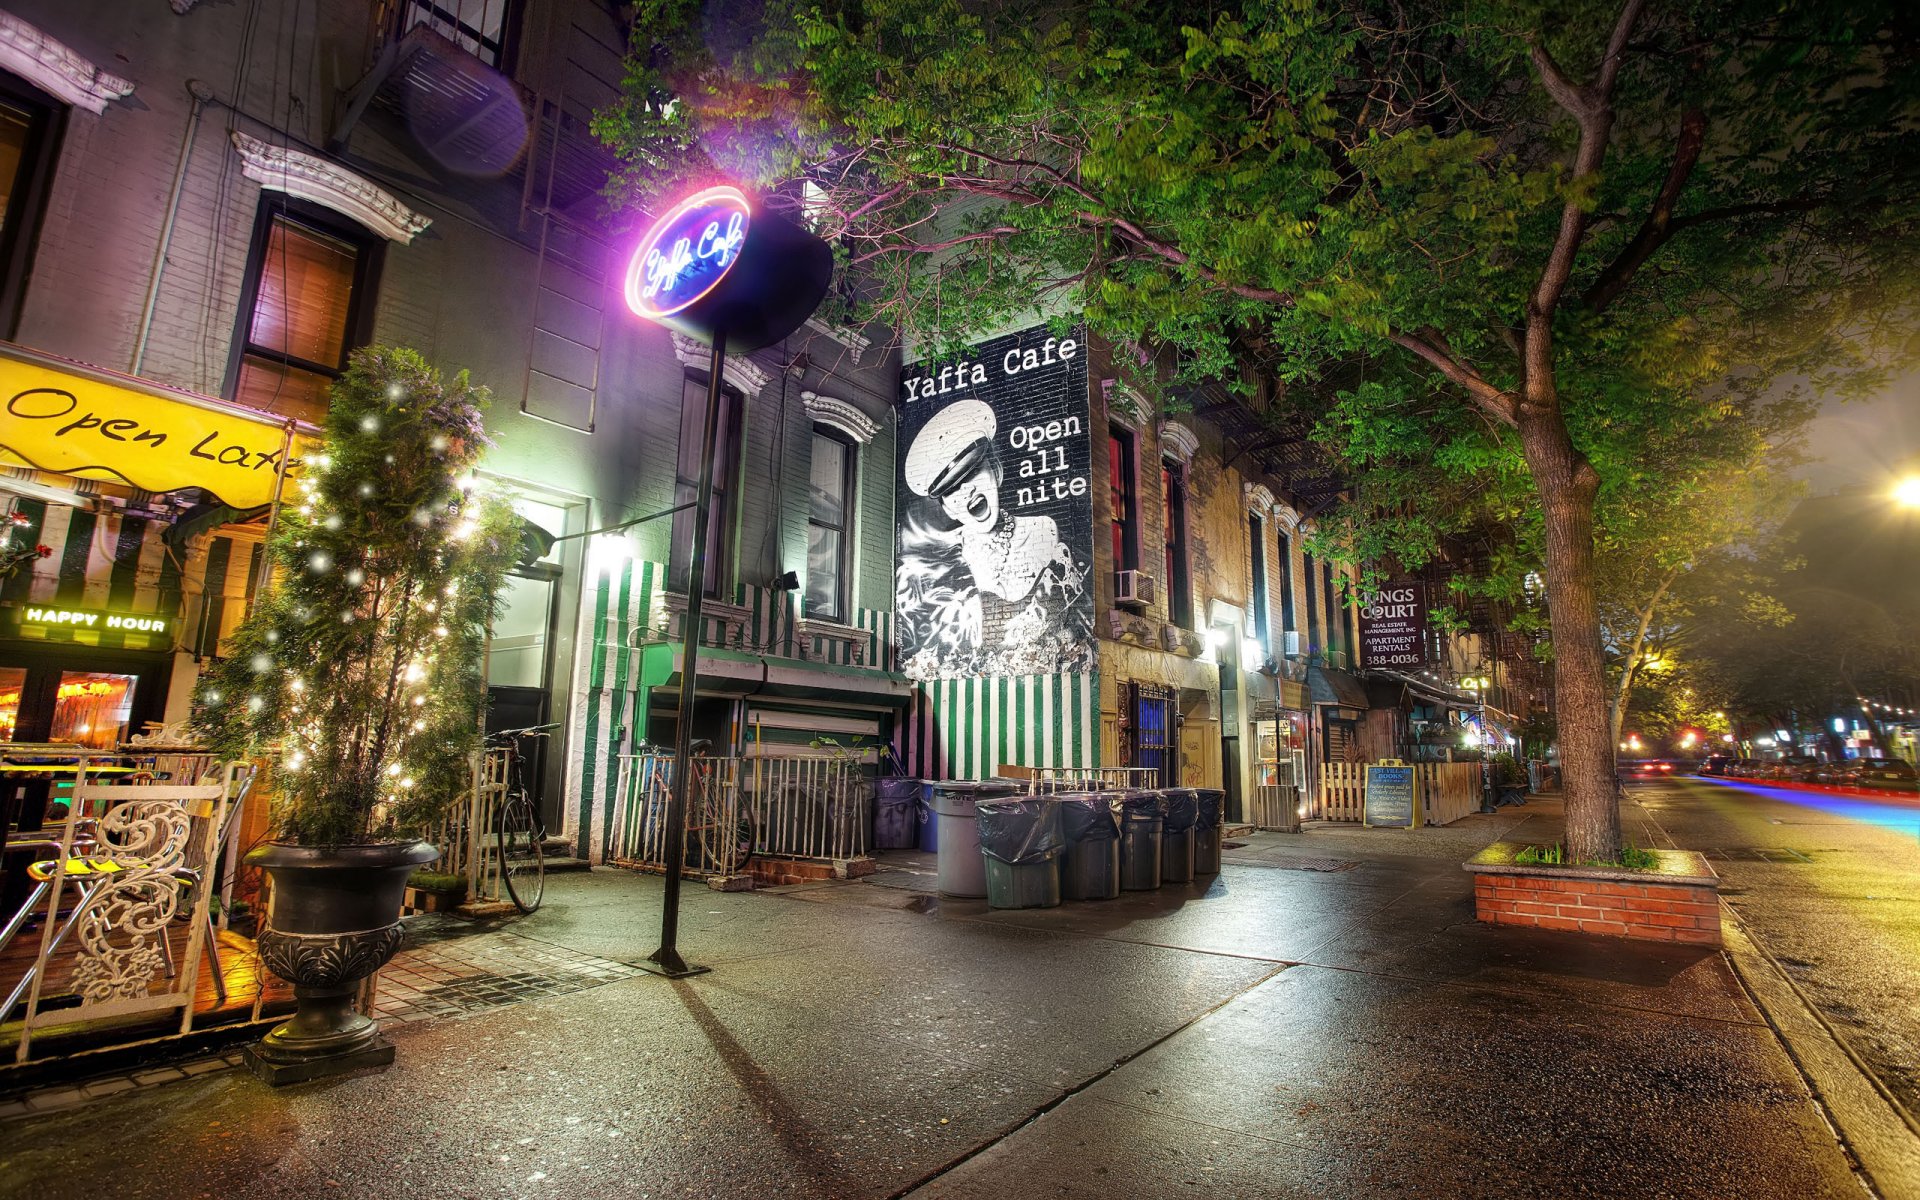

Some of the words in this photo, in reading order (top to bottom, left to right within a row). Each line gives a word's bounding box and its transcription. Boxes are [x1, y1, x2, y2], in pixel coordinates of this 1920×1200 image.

[904, 362, 988, 403] Yaffa
[1003, 337, 1078, 375] Cafe
[6, 387, 168, 448] Open
[189, 430, 304, 479] Late
[1009, 415, 1082, 452] Open
[1018, 446, 1070, 479] all
[1016, 476, 1087, 506] nite
[26, 608, 99, 627] HAPPY
[106, 615, 166, 633] HOUR
[1360, 604, 1418, 620] COURT
[1365, 636, 1416, 645] APARTMENT
[1372, 644, 1410, 652] RENTALS
[1366, 654, 1419, 665] 388-0036
